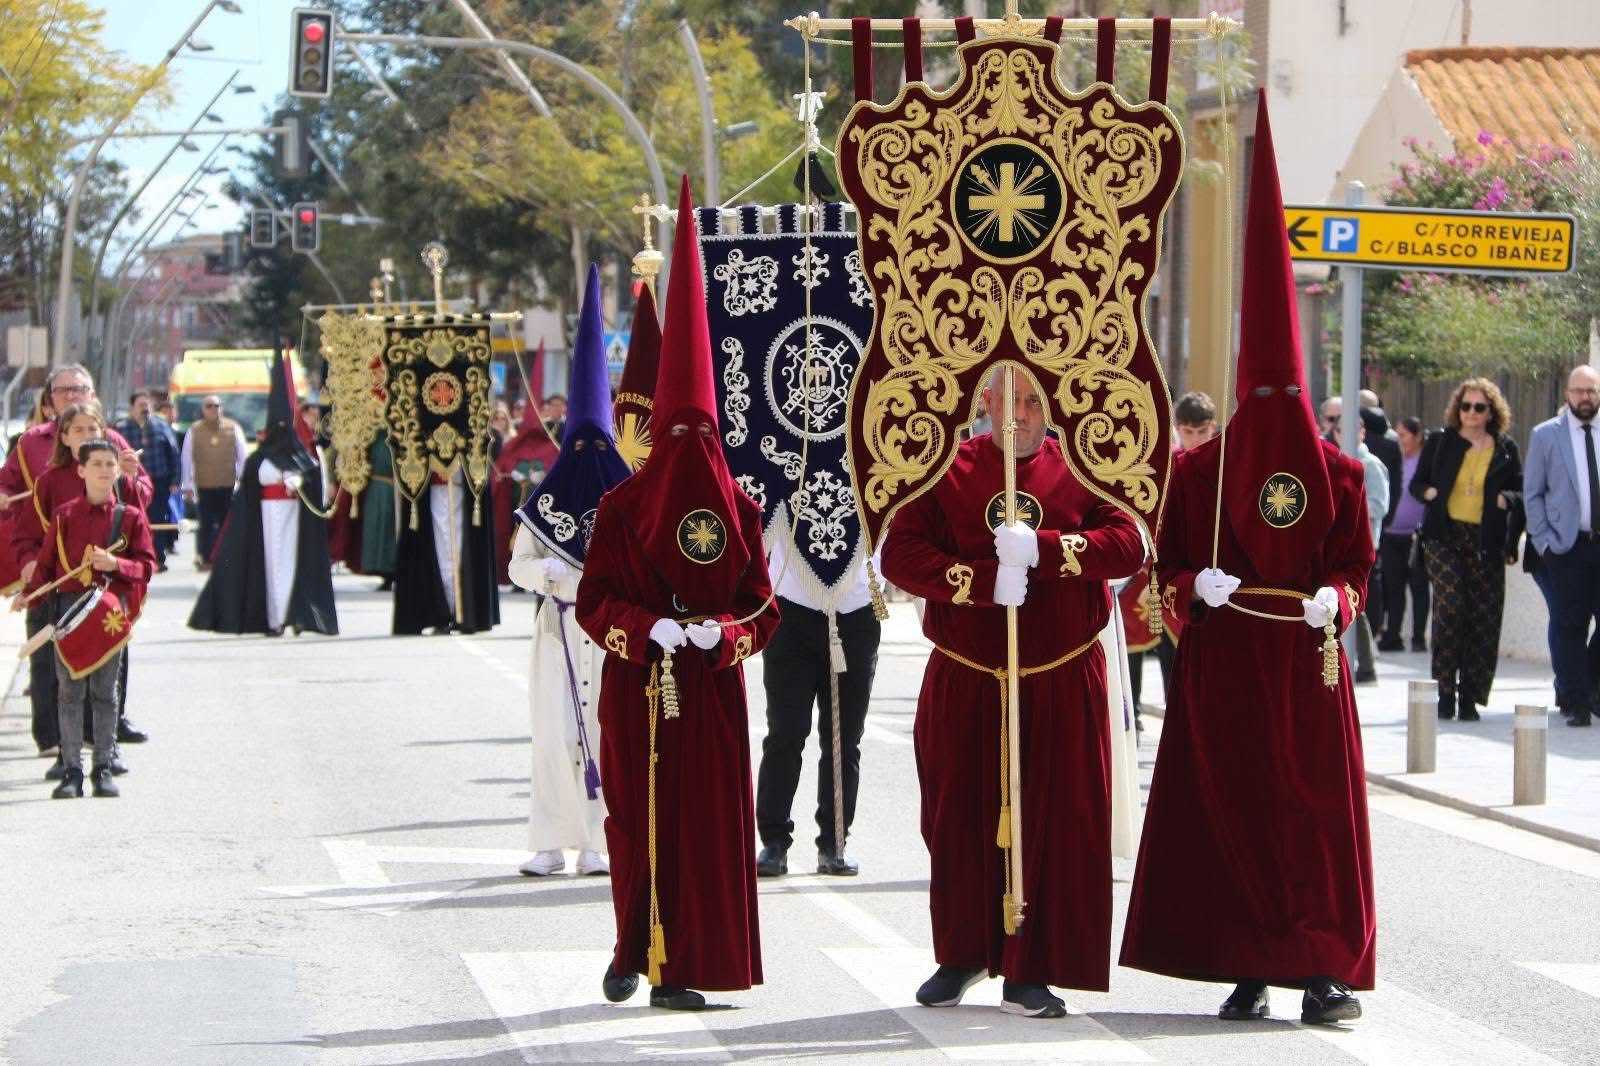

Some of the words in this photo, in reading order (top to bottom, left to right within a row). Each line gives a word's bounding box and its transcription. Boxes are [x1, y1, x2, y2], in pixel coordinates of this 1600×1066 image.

[1329, 220, 1354, 250] P
[1415, 222, 1564, 242] C/TORREVIEJA
[1370, 239, 1478, 258] C/BLASCO
[1489, 243, 1563, 262] IBAÑEZ
